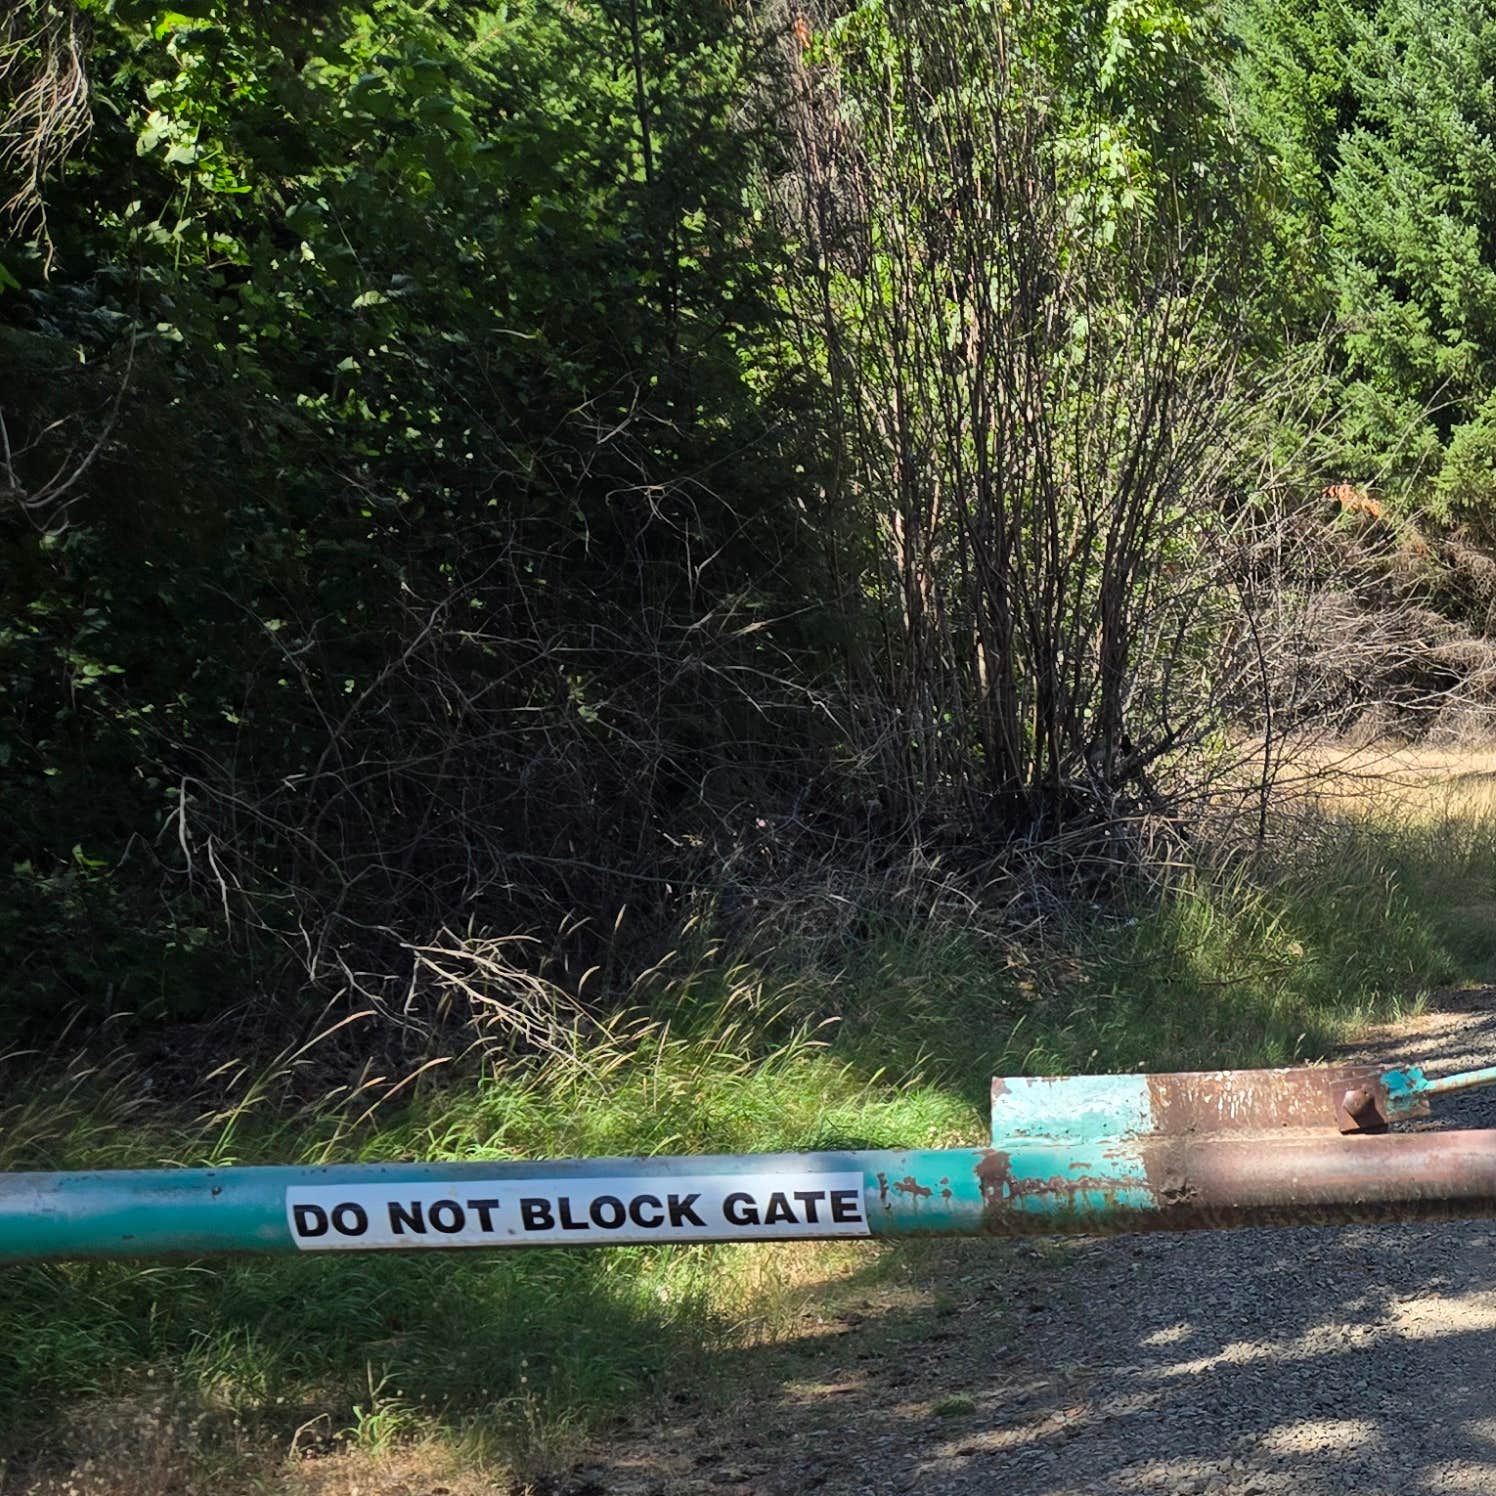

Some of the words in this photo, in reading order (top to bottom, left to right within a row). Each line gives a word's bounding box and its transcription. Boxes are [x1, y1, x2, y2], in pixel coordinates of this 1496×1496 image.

[293, 1203, 368, 1237] DO
[389, 1199, 499, 1235] NOT
[519, 1194, 706, 1231] BLOCK
[722, 1190, 862, 1224] GATE
